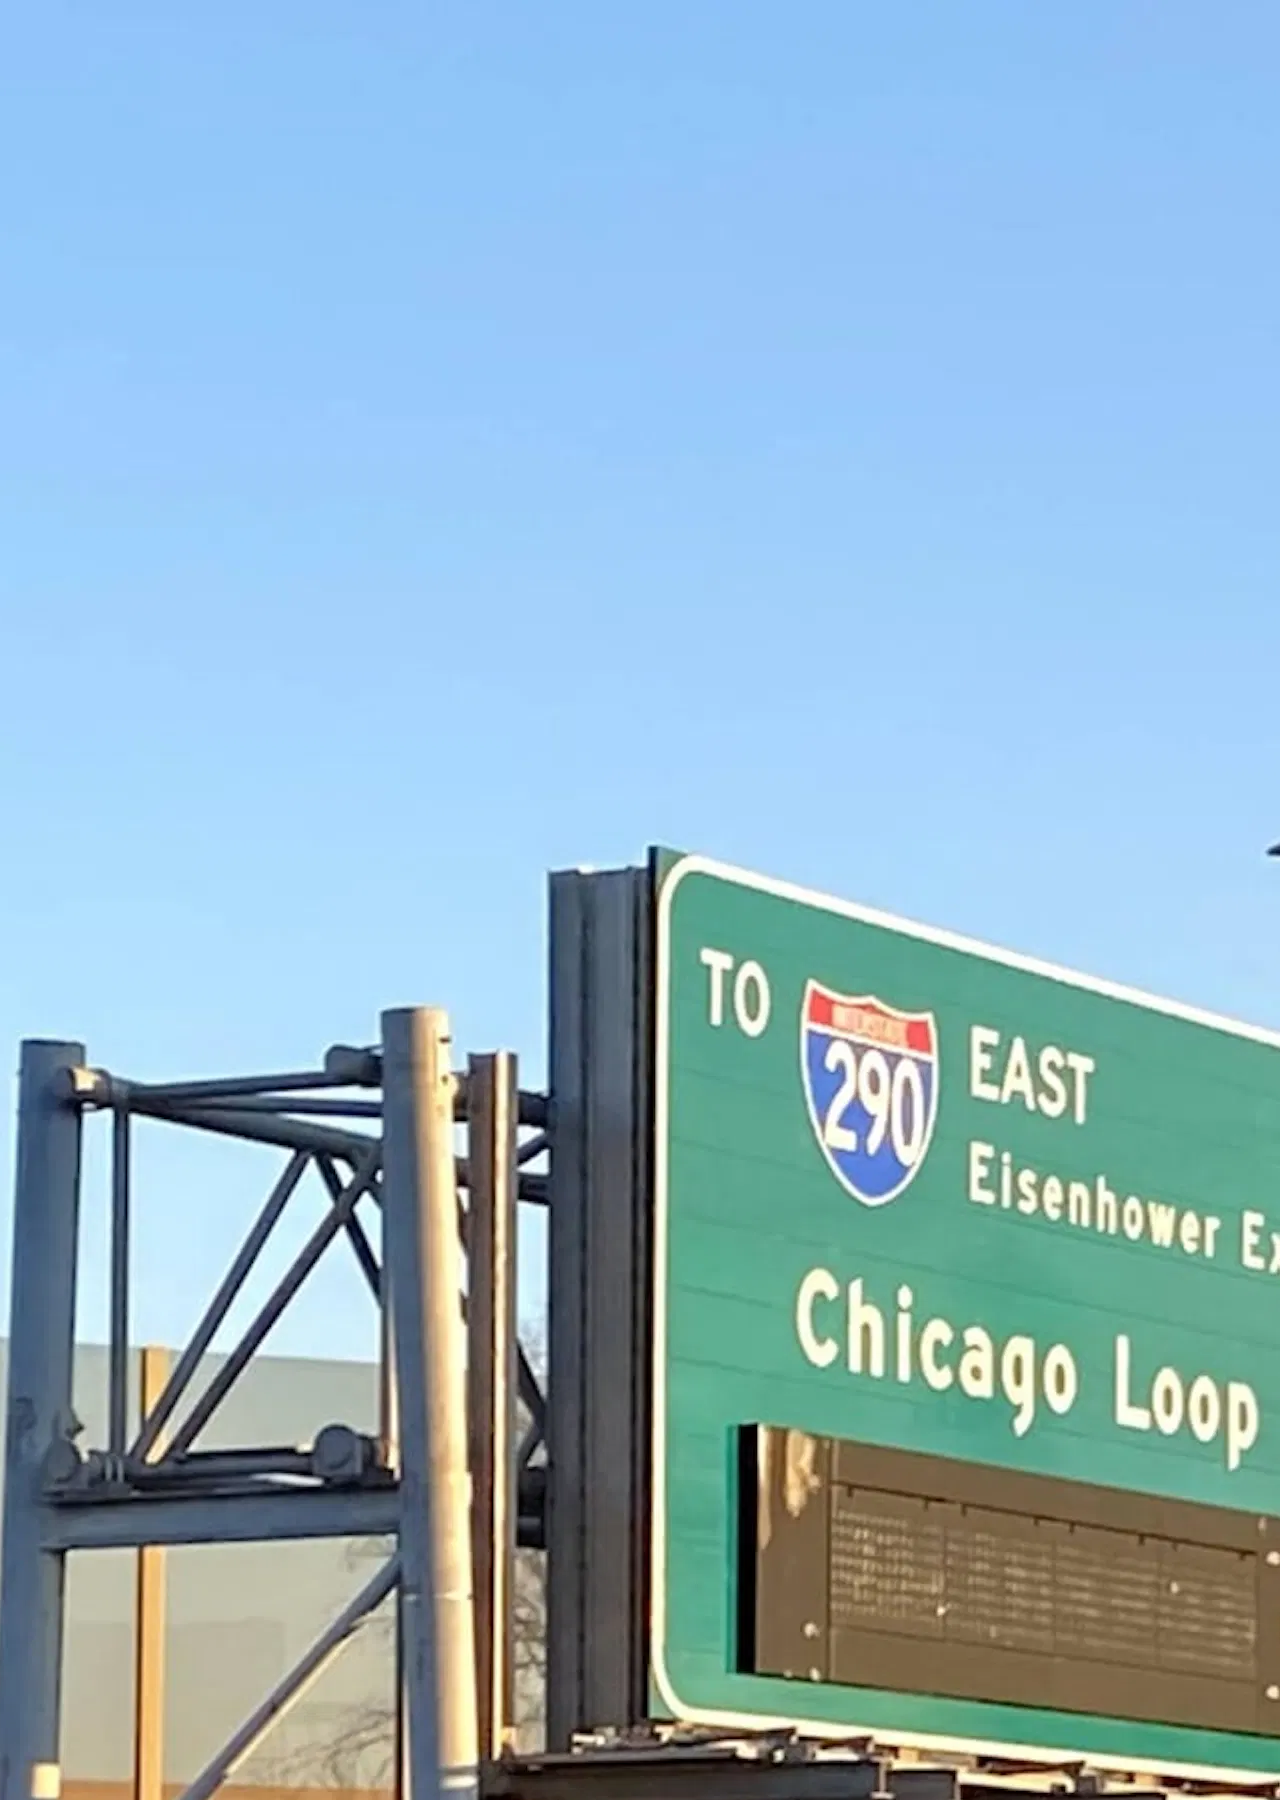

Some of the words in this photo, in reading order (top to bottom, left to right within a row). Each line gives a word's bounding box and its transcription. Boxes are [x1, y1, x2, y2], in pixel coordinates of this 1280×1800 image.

[700, 947, 771, 1037] TO
[824, 1038, 925, 1167] 290
[970, 1025, 1096, 1124] EAST
[969, 1141, 1221, 1257] Eisenhower
[796, 1268, 1078, 1437] Chicago
[1116, 1335, 1259, 1471] Loop
